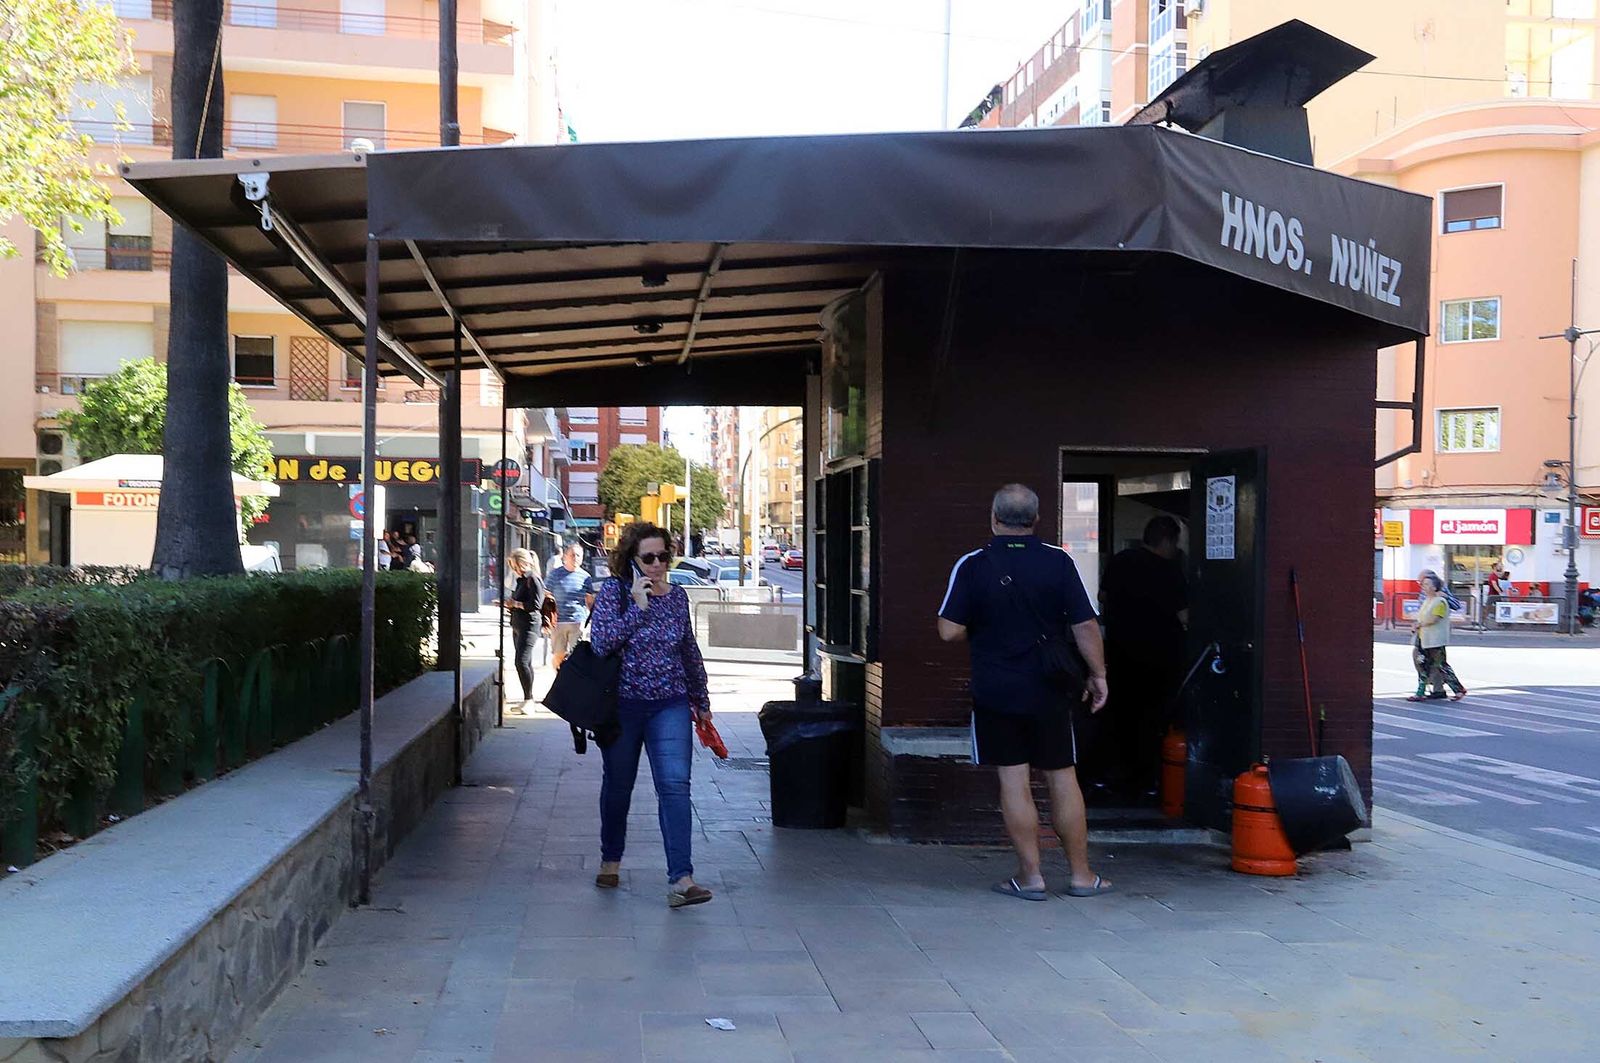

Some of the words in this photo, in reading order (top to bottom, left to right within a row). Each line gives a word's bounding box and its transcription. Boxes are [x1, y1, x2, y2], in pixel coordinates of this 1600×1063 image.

[1221, 191, 1312, 276] HNOS.
[1329, 233, 1402, 307] NUÑEZ
[309, 460, 346, 481] de
[358, 460, 440, 482] UEG
[1441, 520, 1454, 532] el
